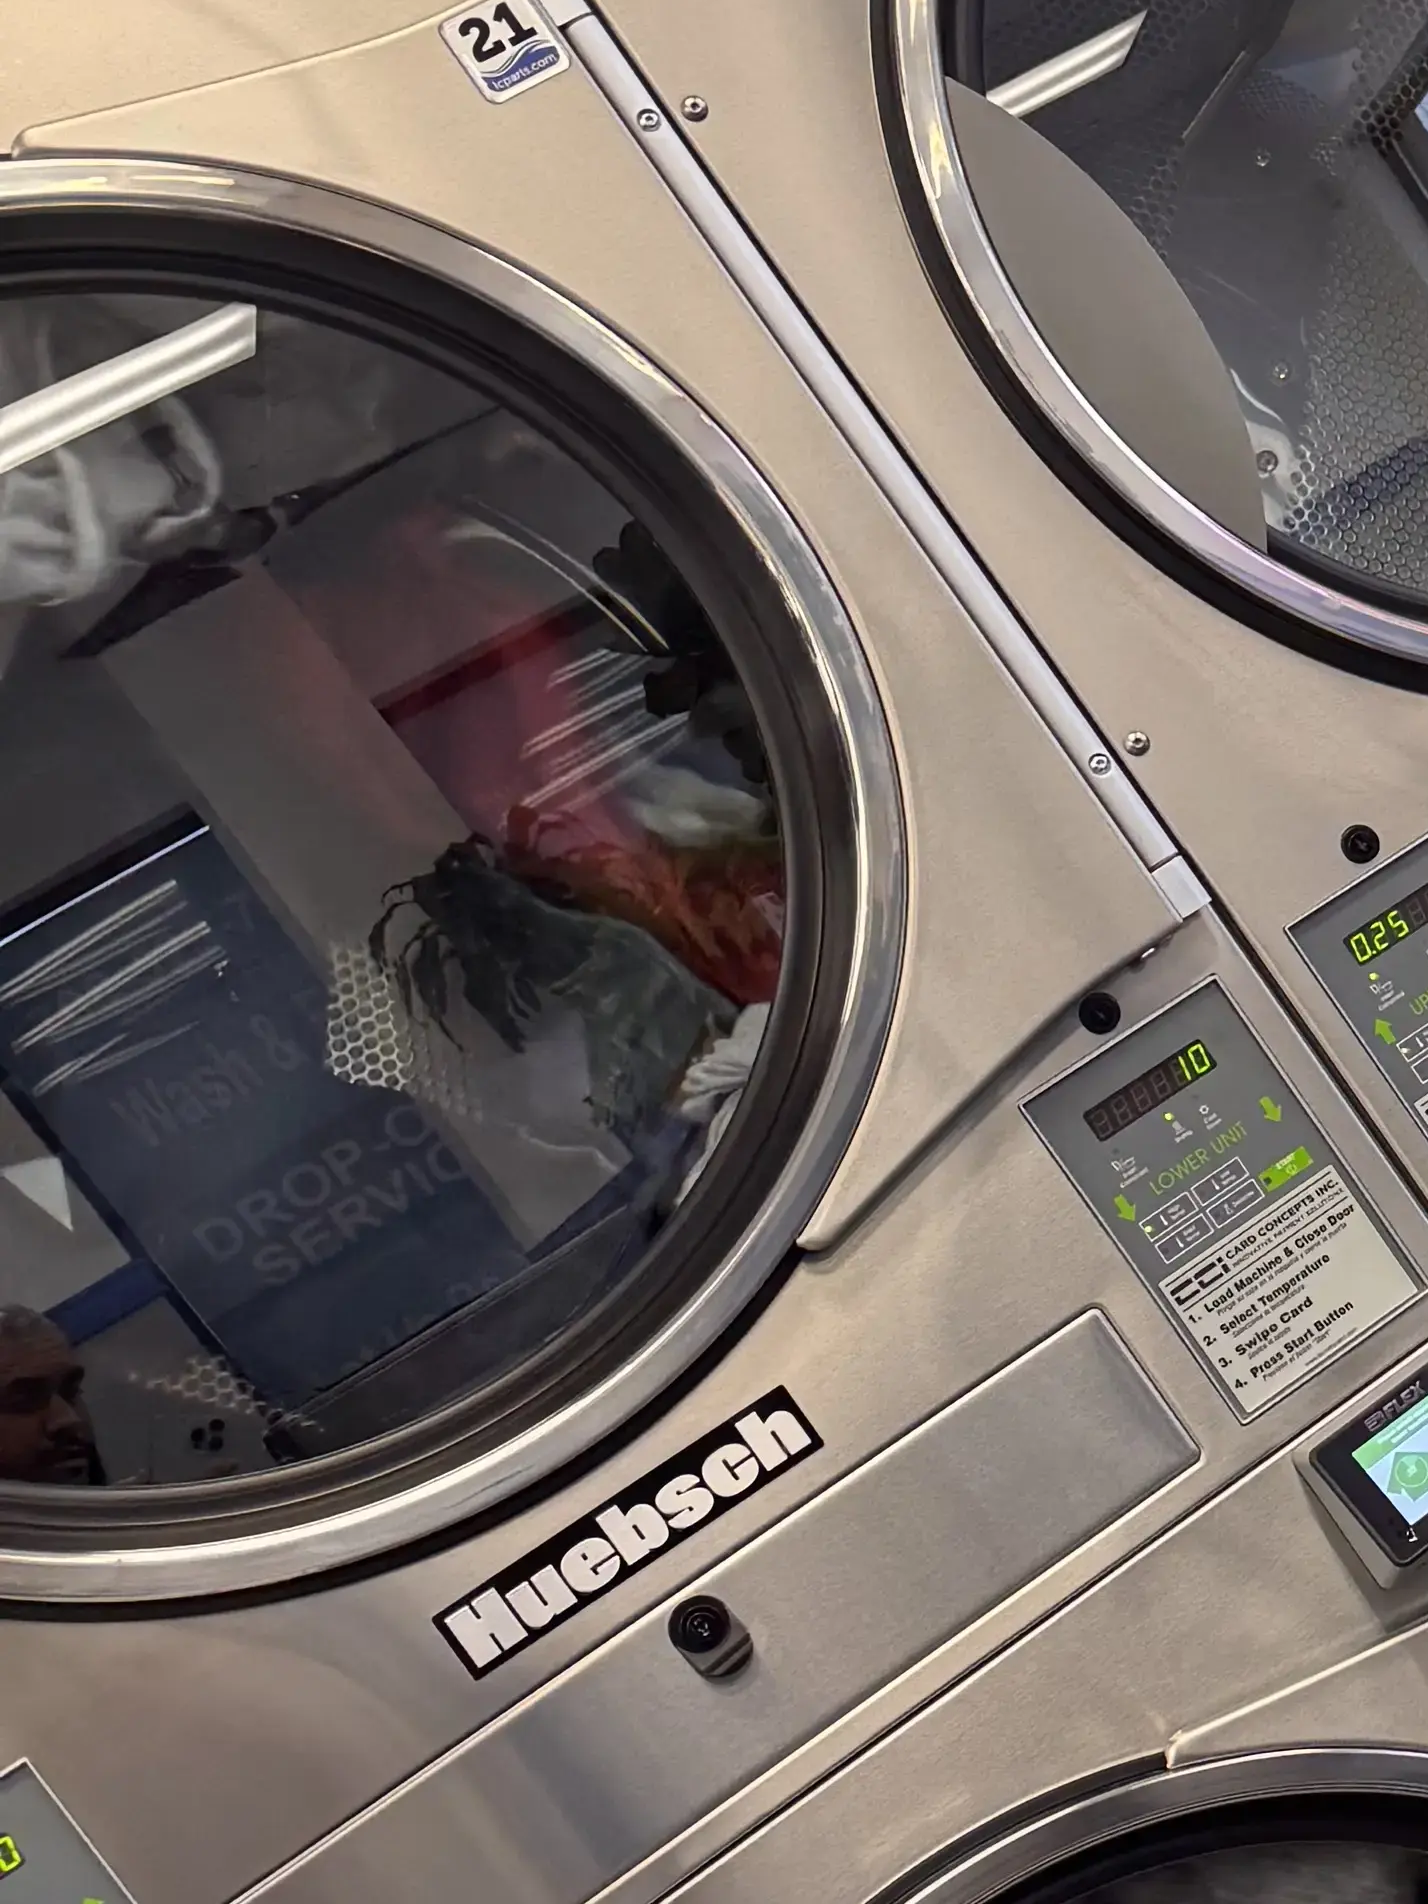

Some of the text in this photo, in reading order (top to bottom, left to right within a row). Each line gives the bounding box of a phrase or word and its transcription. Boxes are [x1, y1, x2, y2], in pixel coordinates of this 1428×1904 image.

[459, 2, 538, 63] 21
[1345, 908, 1412, 964] 0.25
[1172, 1039, 1218, 1082] 10
[194, 1104, 435, 1262] DROP-O
[1148, 1120, 1249, 1195] LOWER UNIT
[253, 1141, 472, 1285] SERVIC
[1224, 1177, 1339, 1260] CARD CONCEPTS INC.
[1203, 1286, 1234, 1313] Load
[1232, 1252, 1283, 1292] Machine
[1281, 1244, 1295, 1258] &
[1293, 1221, 1328, 1250] Close
[1326, 1201, 1356, 1226] Door
[1218, 1302, 1259, 1335] Select
[1256, 1251, 1332, 1309] Temperature
[1234, 1319, 1280, 1358] Swipe
[1278, 1295, 1314, 1325] Card
[1249, 1348, 1285, 1378] Press
[1282, 1326, 1315, 1354] Start
[1313, 1298, 1355, 1332] Button
[1383, 1381, 1426, 1419] FLEX
[443, 1409, 813, 1669] Huebsch
